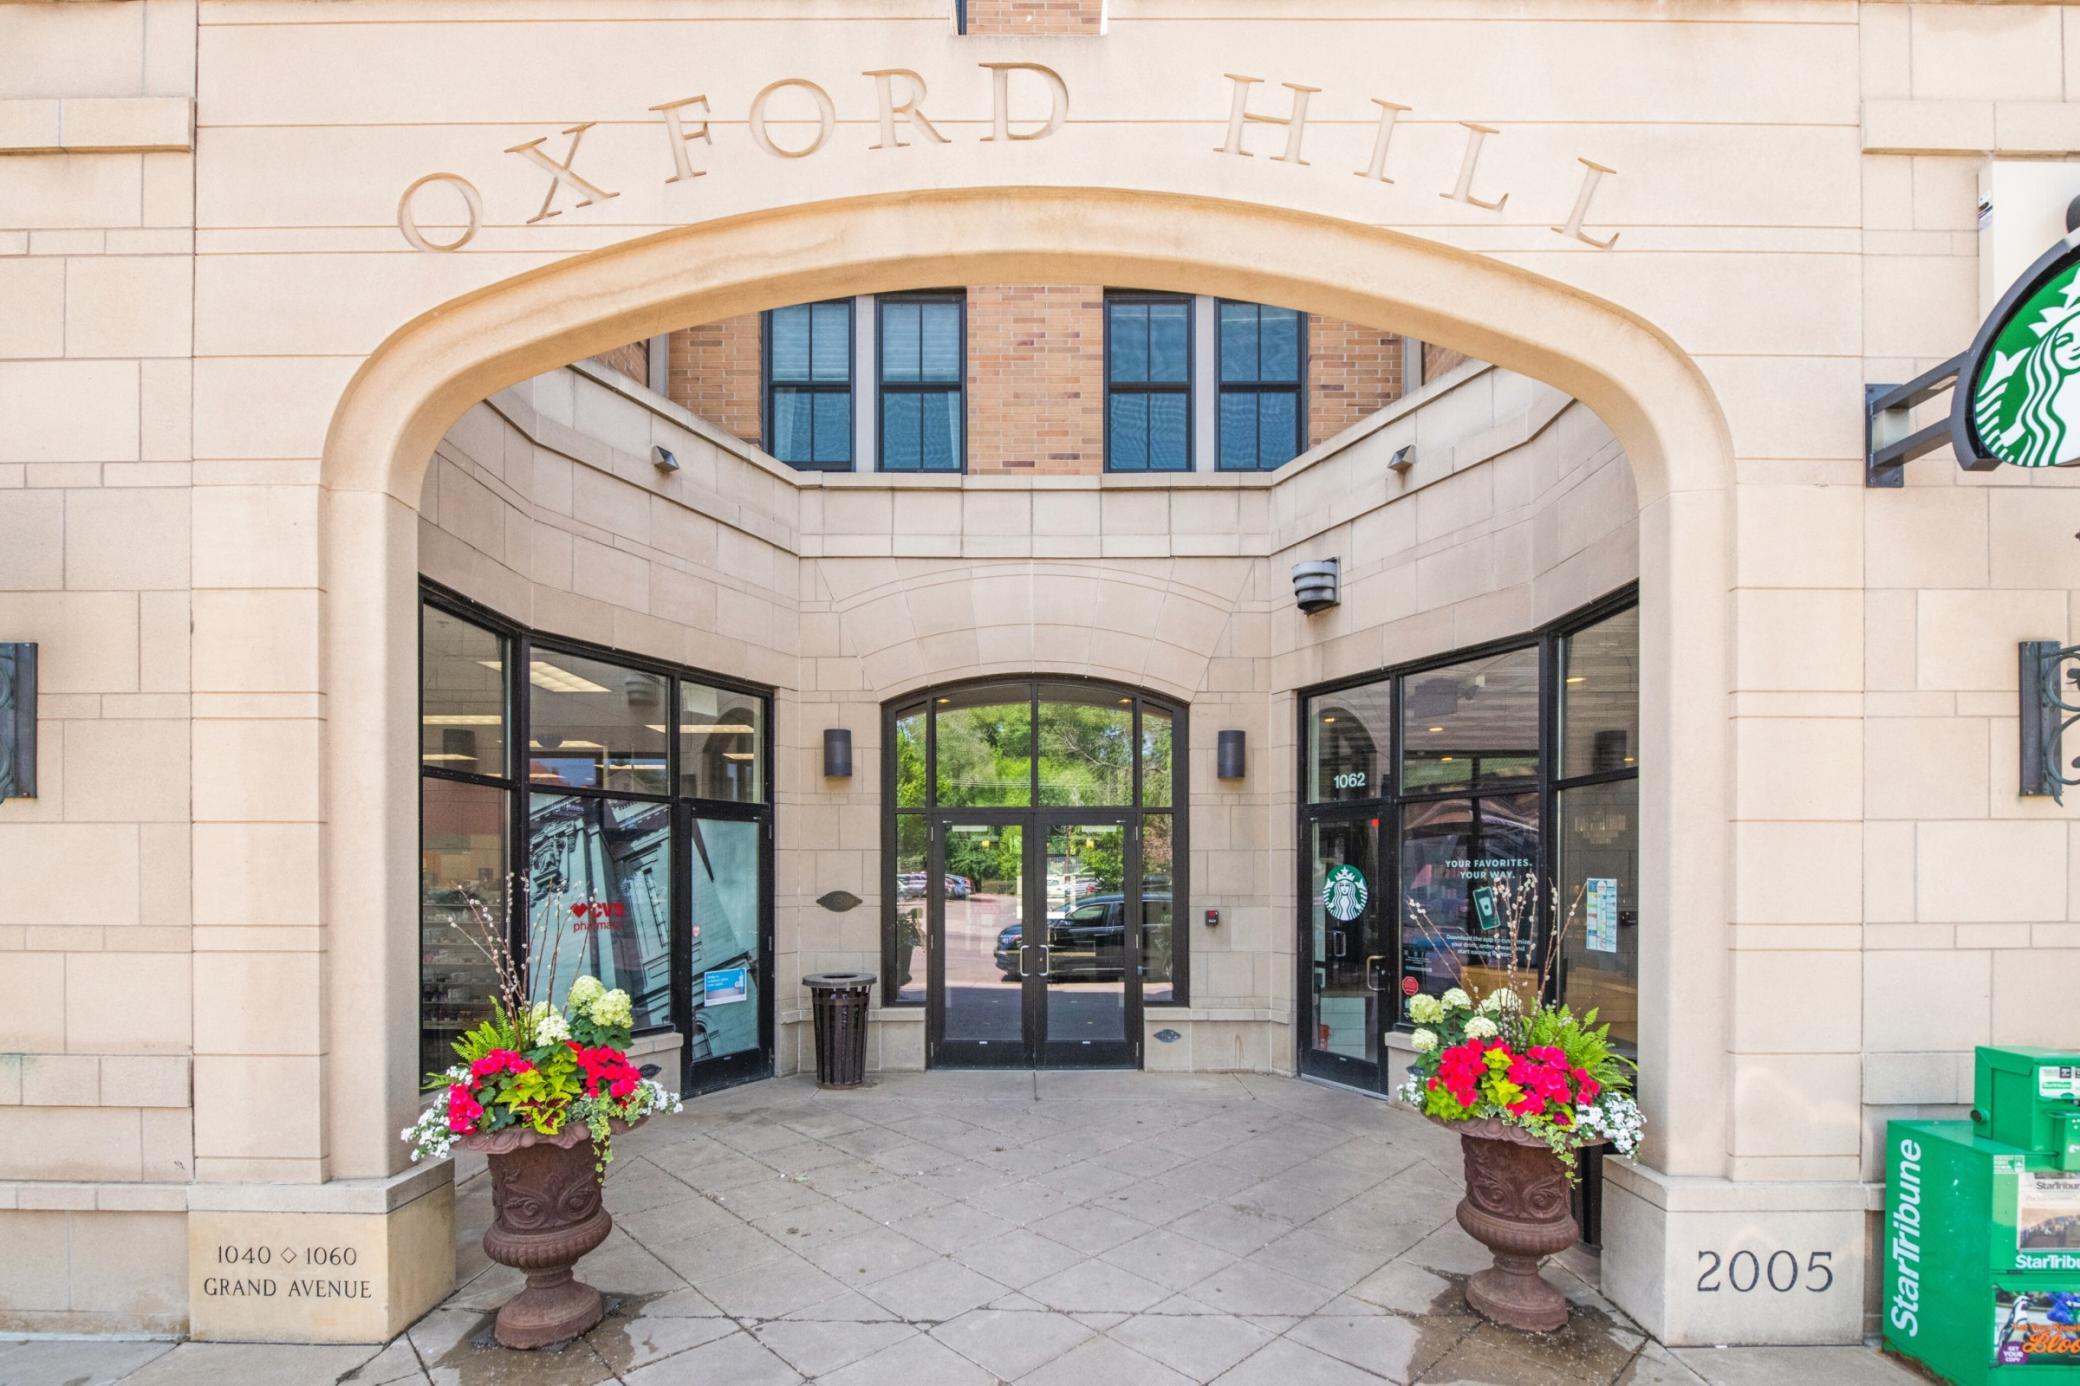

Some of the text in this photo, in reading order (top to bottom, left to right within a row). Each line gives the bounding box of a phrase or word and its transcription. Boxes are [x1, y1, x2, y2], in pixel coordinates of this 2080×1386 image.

[397, 61, 1620, 252] OXFORD HILL
[1333, 772, 1366, 789] 1062
[1445, 859, 1533, 868] YOUR FAVORITES.
[1460, 871, 1516, 879] YOUR WAY.
[590, 901, 625, 918] CVS
[1890, 1138, 1922, 1338] StarTribune
[217, 1245, 357, 1266] 1040 1060
[1697, 1250, 1833, 1292] 2005
[203, 1278, 372, 1299] GRAND AVENUE
